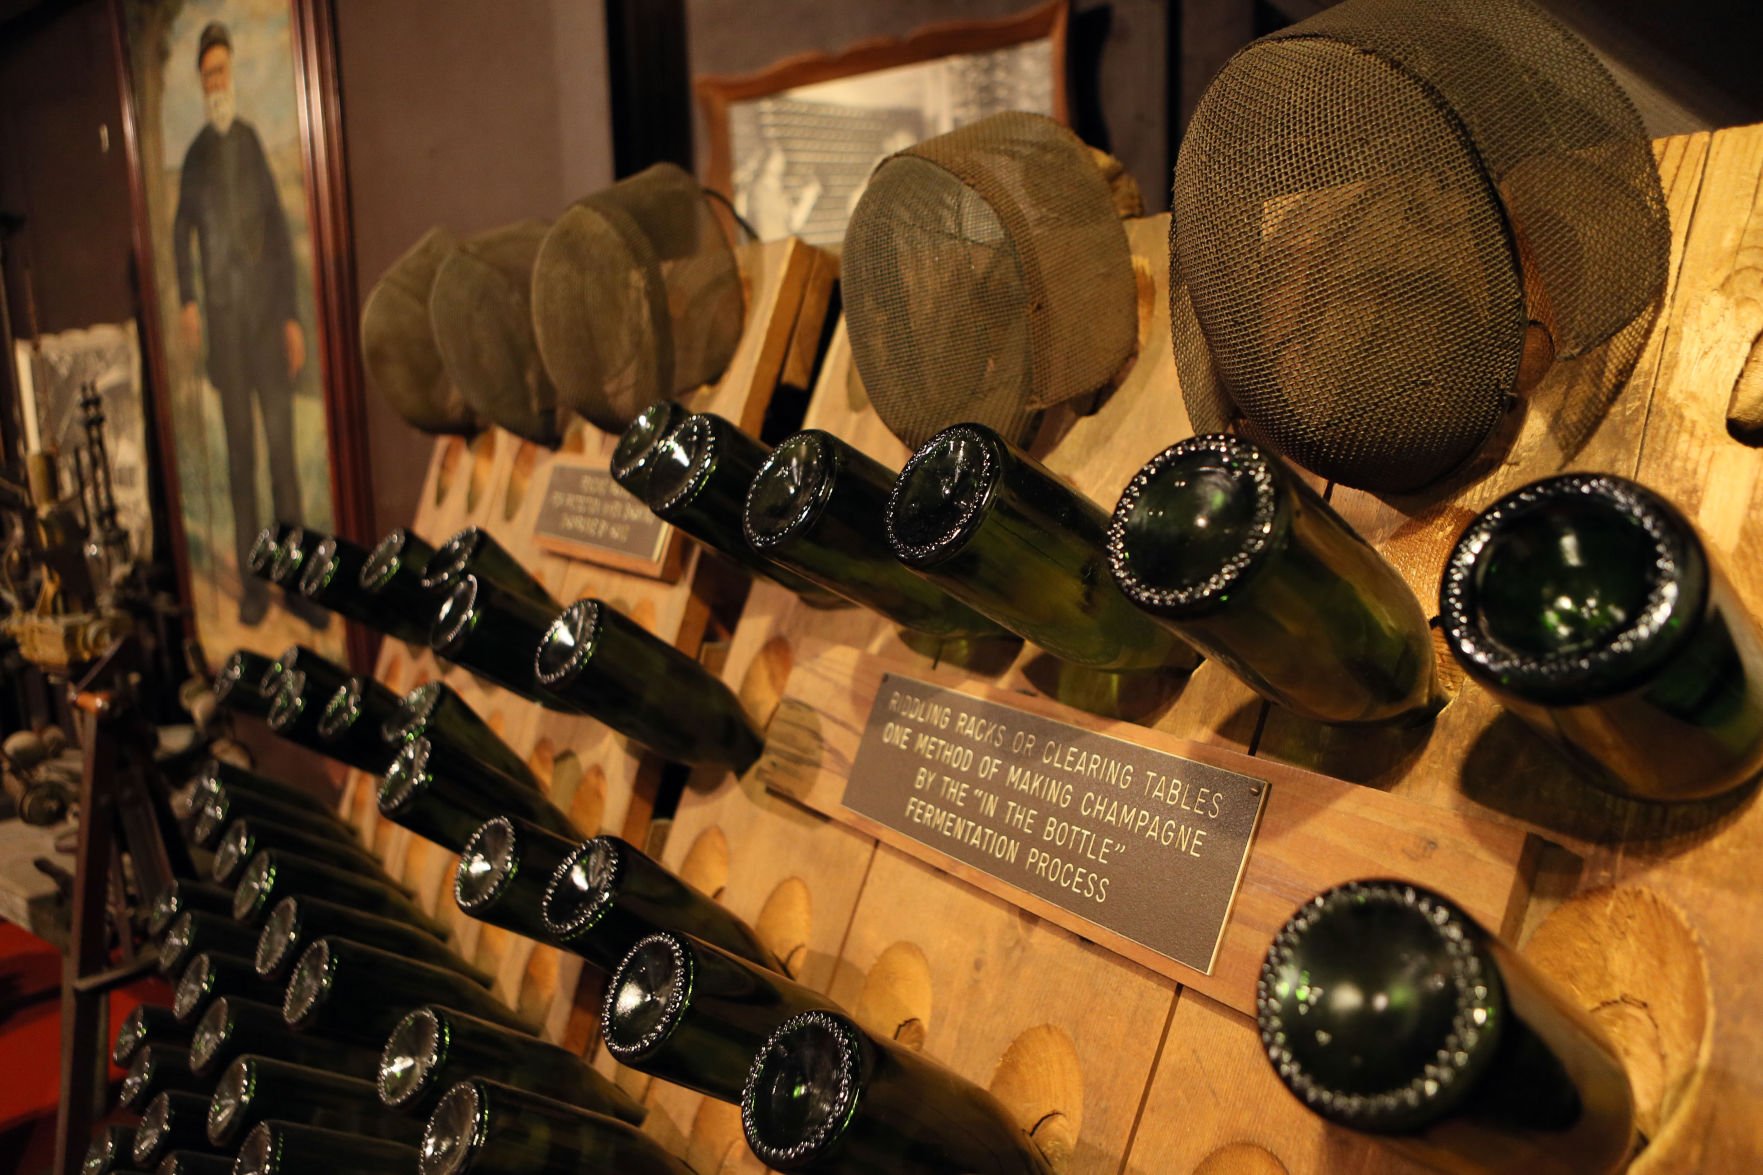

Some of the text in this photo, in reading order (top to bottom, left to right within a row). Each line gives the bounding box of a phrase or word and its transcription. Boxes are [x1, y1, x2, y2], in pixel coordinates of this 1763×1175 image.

[882, 722, 1207, 858] ONE METHOD OF MAKING CHAMPAGNE
[889, 691, 1224, 819] RIDDLING RACKS OR CLEARING TABLES
[913, 767, 937, 792] BY
[940, 776, 969, 807] THE
[1004, 800, 1037, 833] THE
[904, 797, 1110, 904] FERMENTATION PROCESS
